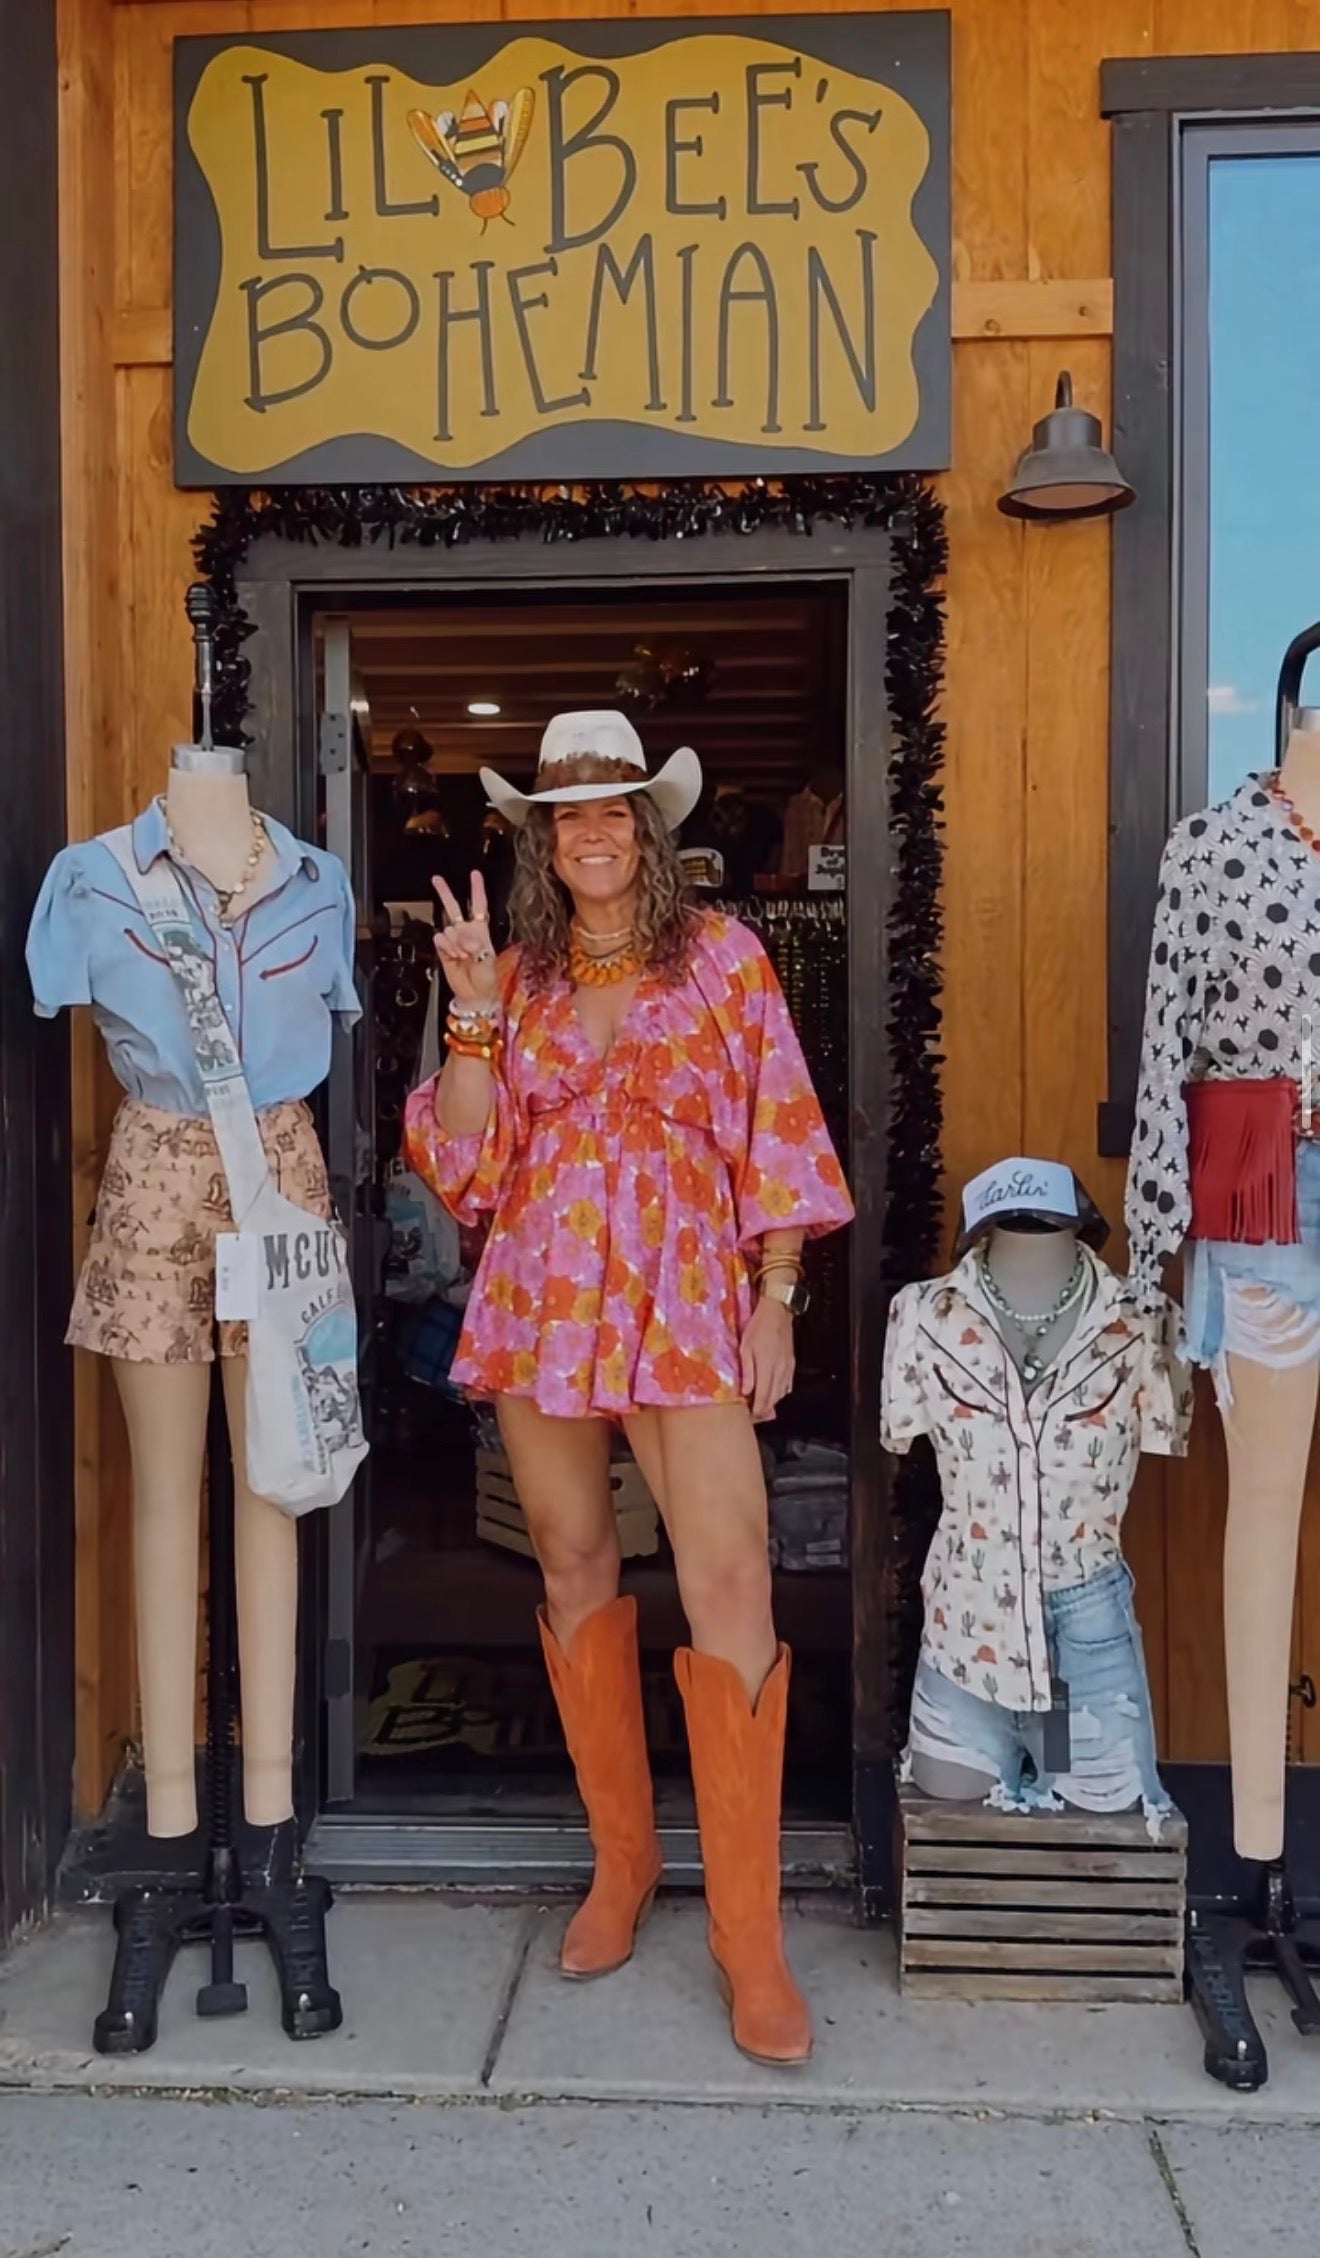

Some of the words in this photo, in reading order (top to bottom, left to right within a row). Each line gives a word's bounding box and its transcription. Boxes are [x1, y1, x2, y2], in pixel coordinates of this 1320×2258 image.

[241, 72, 441, 263] LIL
[538, 57, 883, 254] BEE'S
[239, 229, 878, 442] BOHEMIAN
